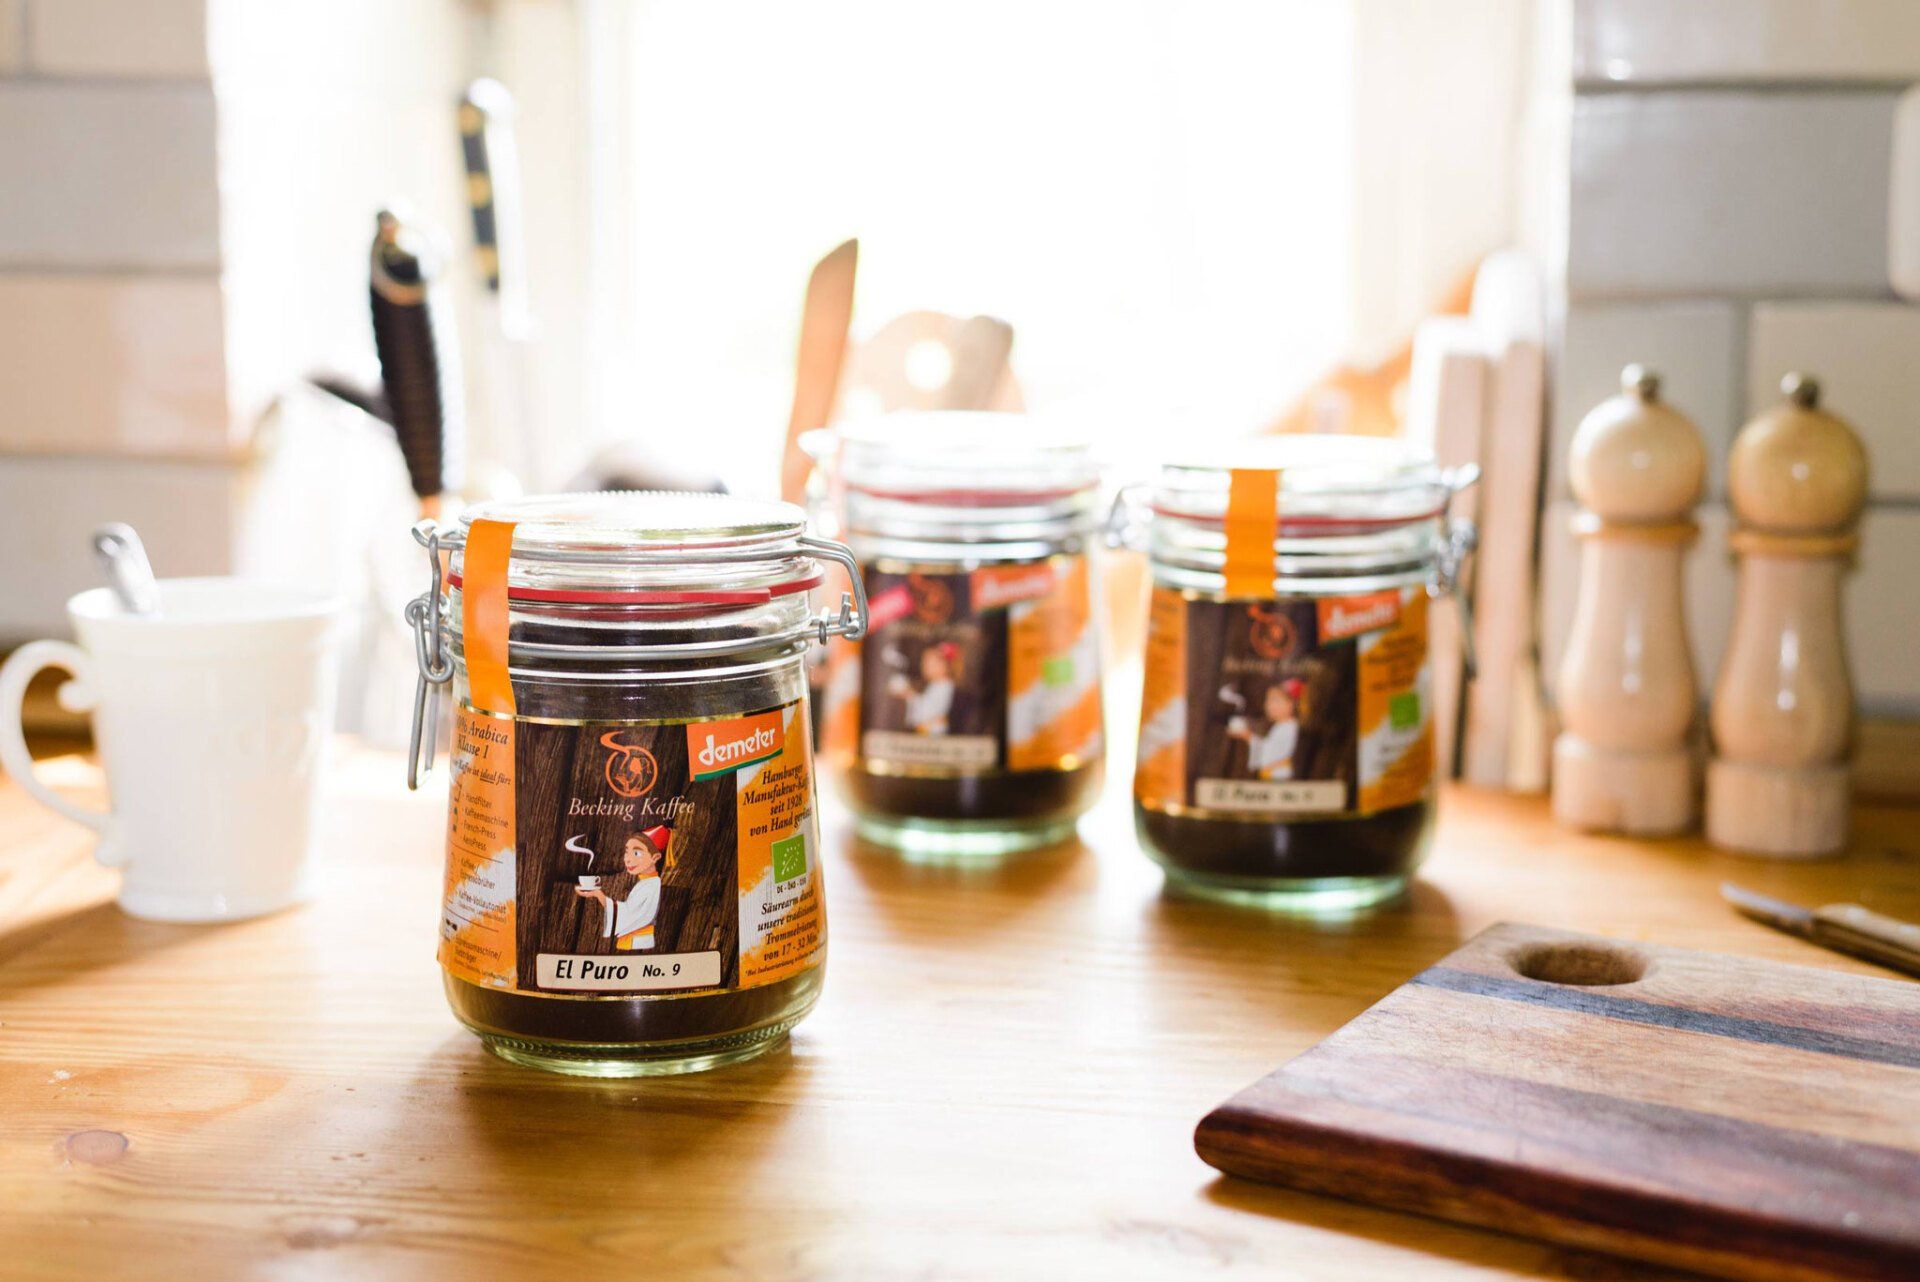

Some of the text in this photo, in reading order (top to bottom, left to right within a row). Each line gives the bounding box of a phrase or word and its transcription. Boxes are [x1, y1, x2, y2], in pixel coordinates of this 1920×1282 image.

[469, 721, 508, 745] Arabica
[457, 733, 480, 757] Klasse
[698, 727, 776, 766] demeter
[480, 768, 497, 784] ideal
[568, 795, 696, 822] Becking Kaffee
[770, 801, 784, 815] seit
[749, 824, 768, 837] von
[770, 812, 793, 832] Hand
[761, 896, 799, 915] Säurearm
[757, 917, 785, 931] unsere
[763, 949, 779, 961] von
[782, 943, 792, 956] 17
[555, 959, 681, 980] El Puro No. 9
